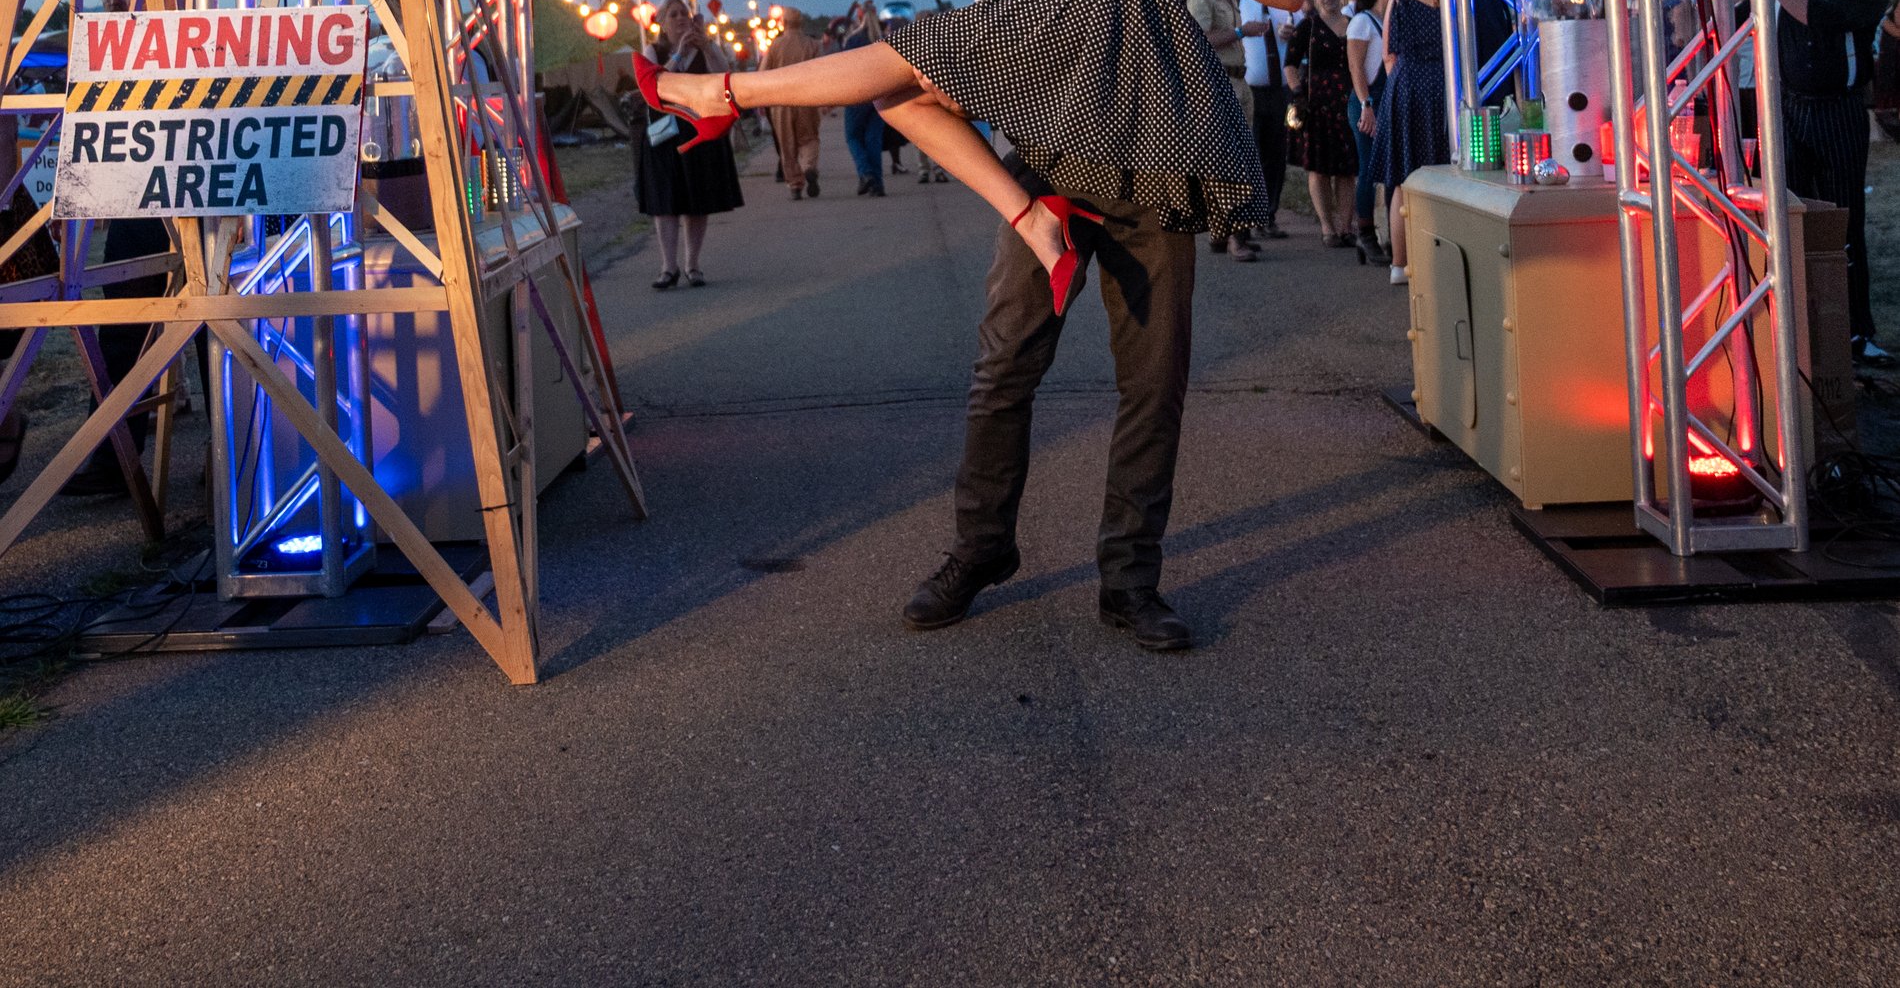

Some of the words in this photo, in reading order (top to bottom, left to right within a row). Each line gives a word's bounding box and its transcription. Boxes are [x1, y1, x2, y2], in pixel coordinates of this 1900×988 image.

[87, 13, 355, 72] WARNING
[72, 114, 347, 163] RESTRICTED
[138, 163, 269, 210] AREA
